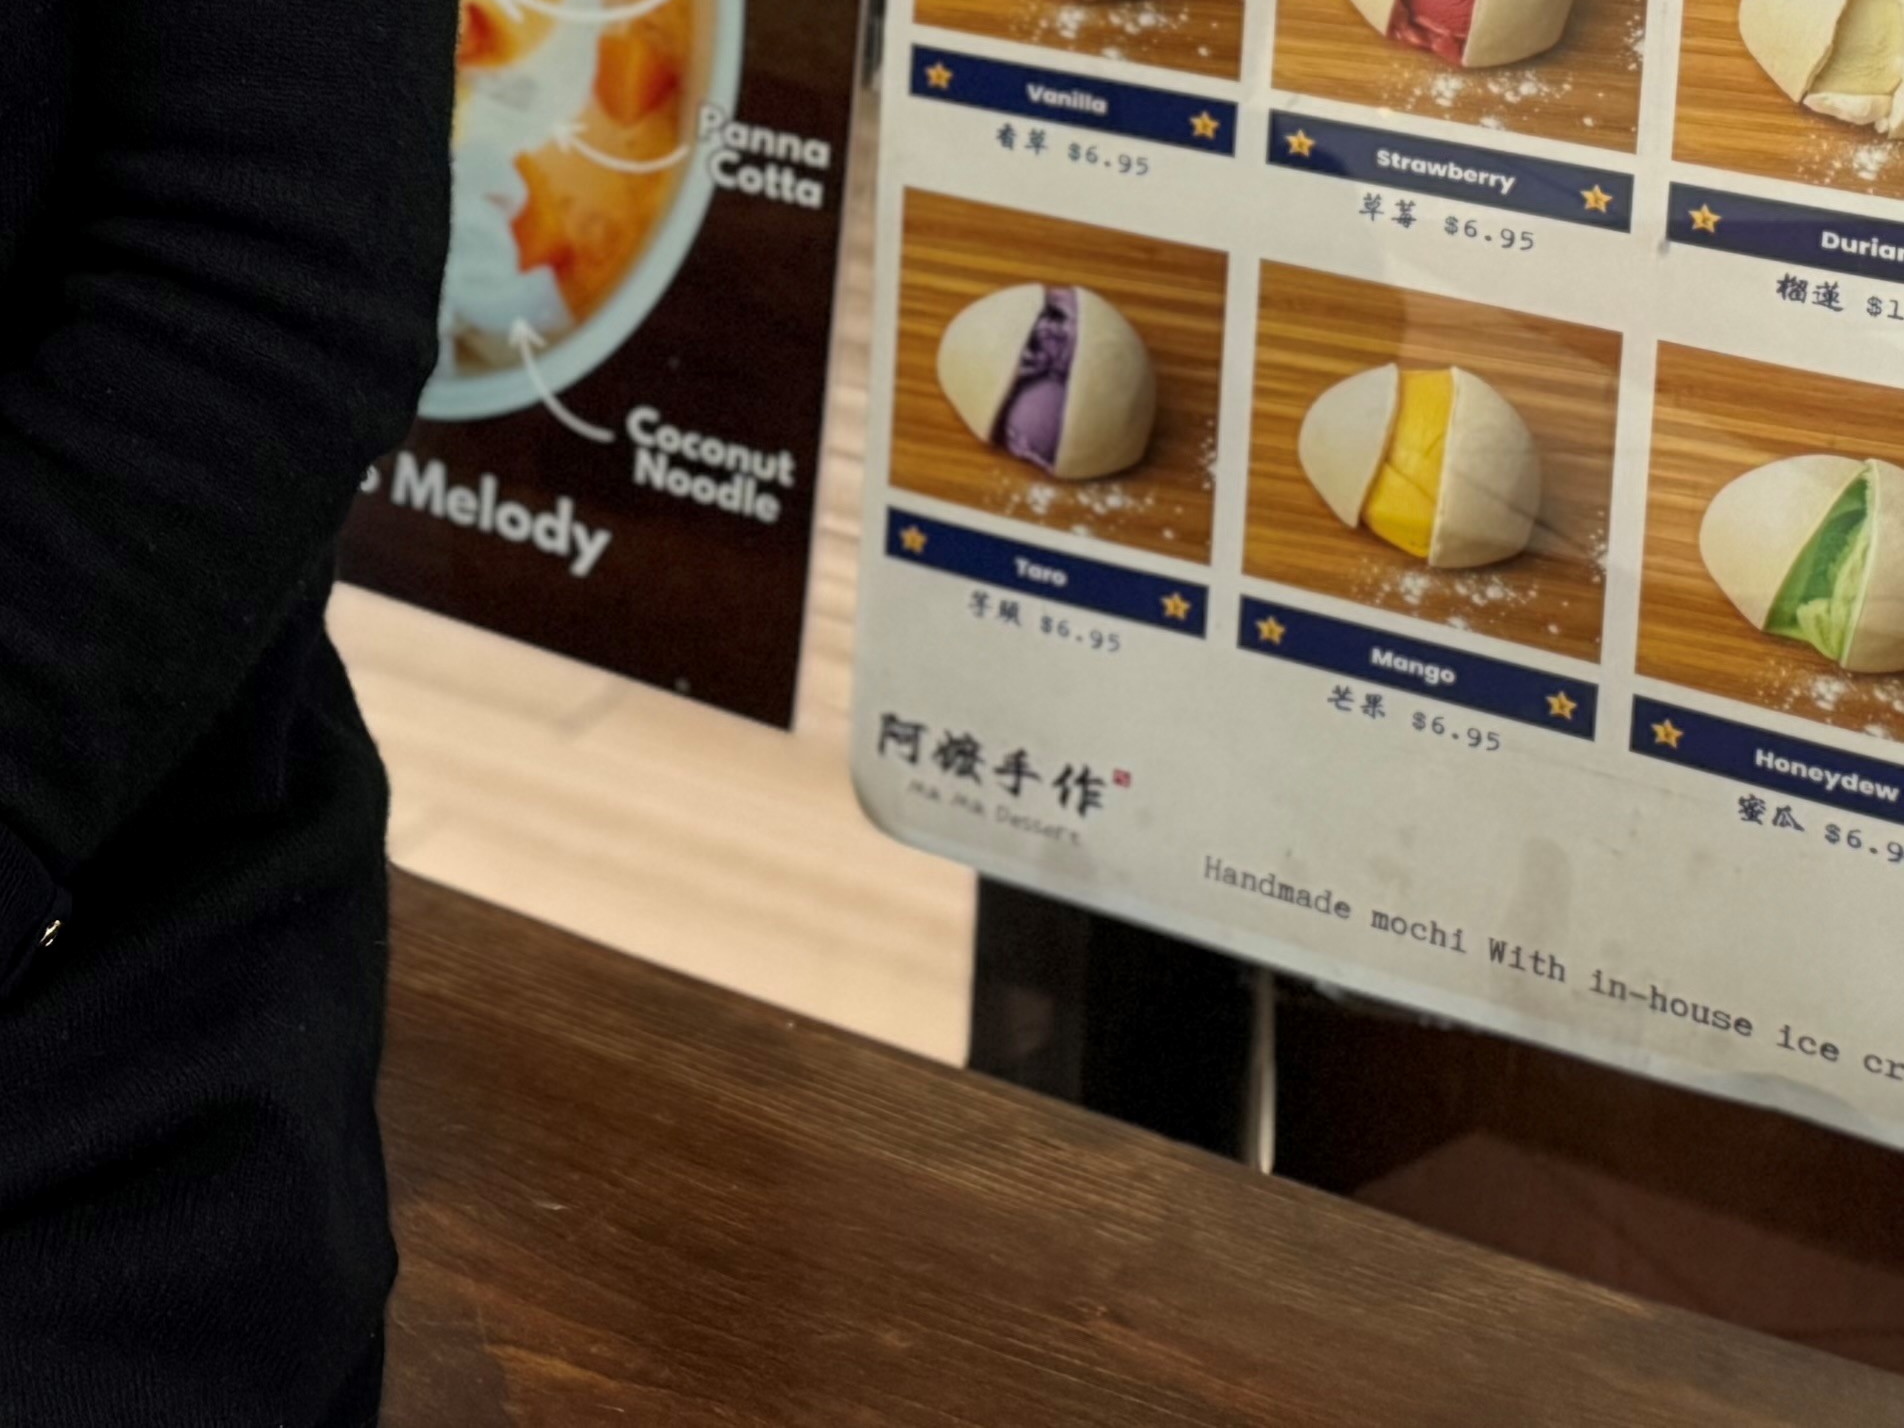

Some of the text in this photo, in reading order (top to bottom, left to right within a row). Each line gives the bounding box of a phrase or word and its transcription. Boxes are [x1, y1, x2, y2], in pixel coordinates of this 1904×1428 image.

[1026, 81, 1109, 118] Vanilla
[699, 105, 831, 170] Panna
[1068, 141, 1152, 178] $6.95
[709, 151, 824, 210] Cotta
[1374, 147, 1516, 196] Strawberry
[1358, 192, 1537, 253] 草莓 $6.95
[624, 404, 796, 488] Coconut
[633, 449, 782, 523] Noodle
[389, 449, 612, 578] Melody
[1015, 554, 1067, 591] Taro
[1039, 611, 1123, 654] $6.95
[1371, 644, 1457, 688] Mango
[1411, 710, 1503, 754] $6.95
[1755, 749, 1900, 801] Honeydew
[1203, 854, 1840, 1064] Handmade mochi With in-house ice
